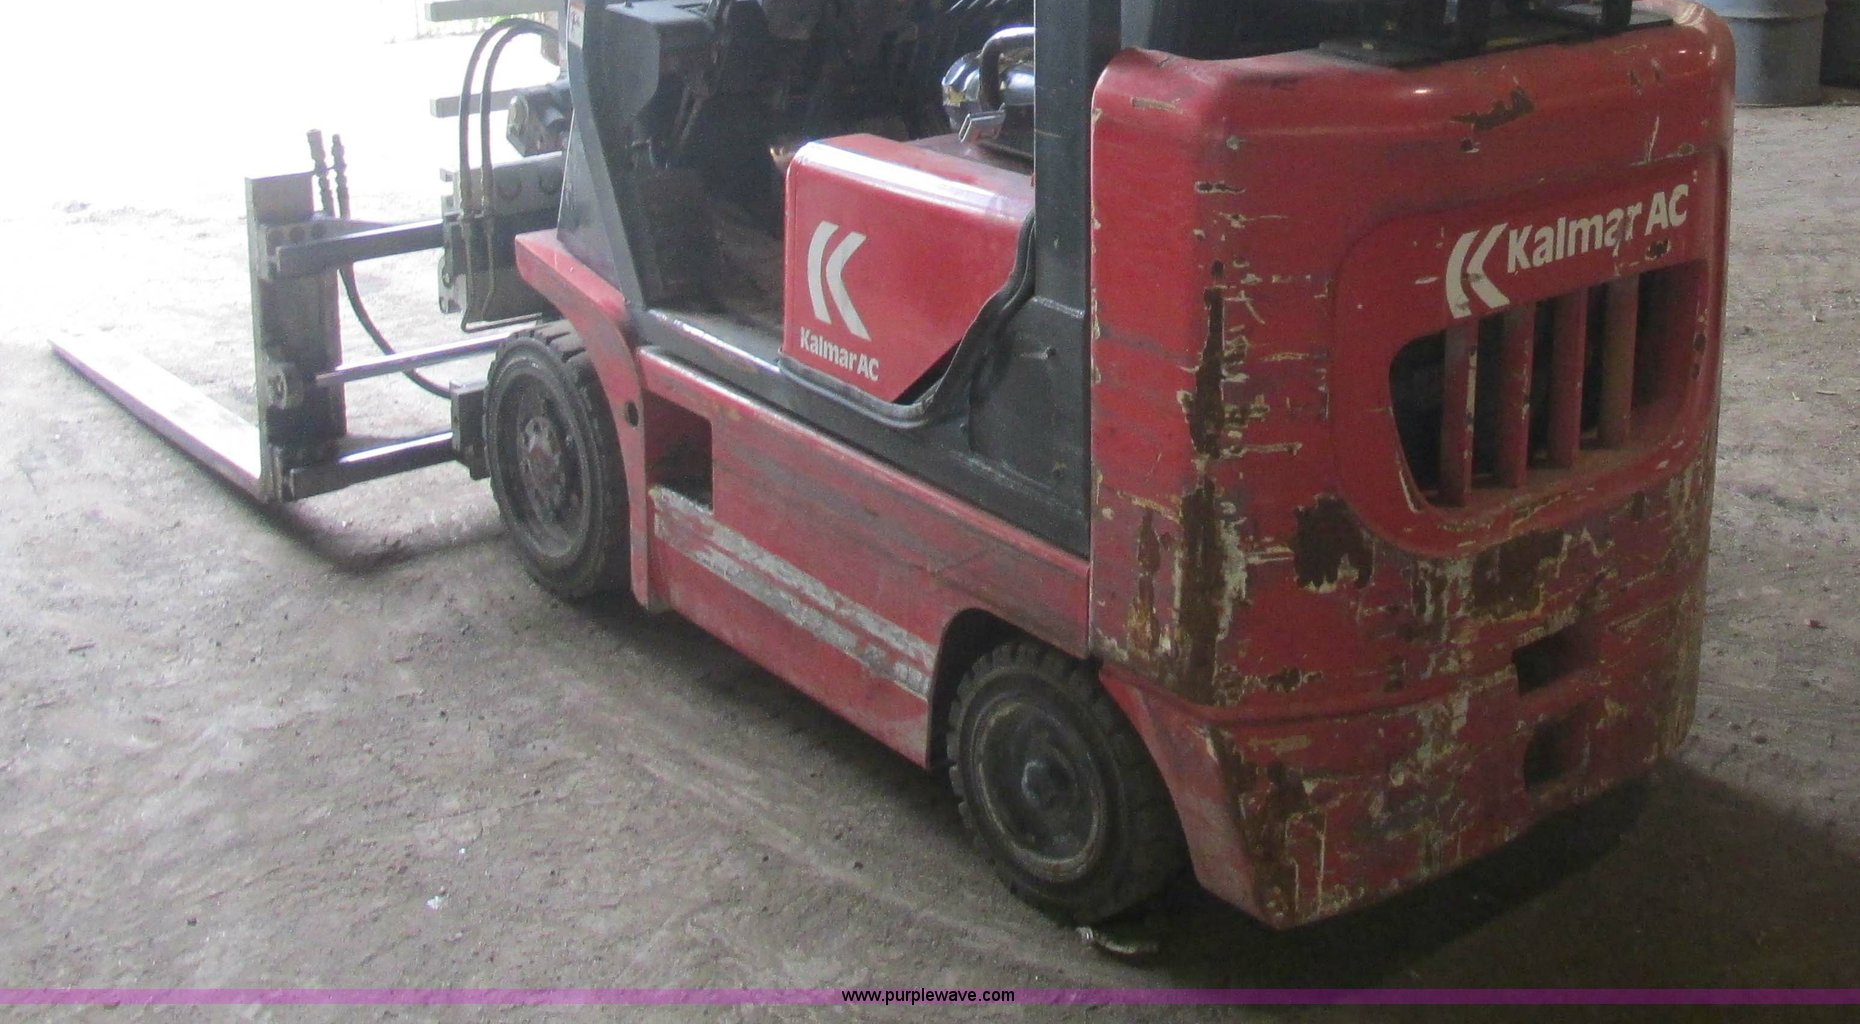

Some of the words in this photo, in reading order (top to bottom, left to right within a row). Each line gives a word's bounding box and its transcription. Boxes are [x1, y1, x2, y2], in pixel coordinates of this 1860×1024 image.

[1507, 201, 1643, 274] Kalmar
[1644, 184, 1689, 236] AC
[800, 326, 858, 371] Kalmar
[856, 353, 880, 382] AC
